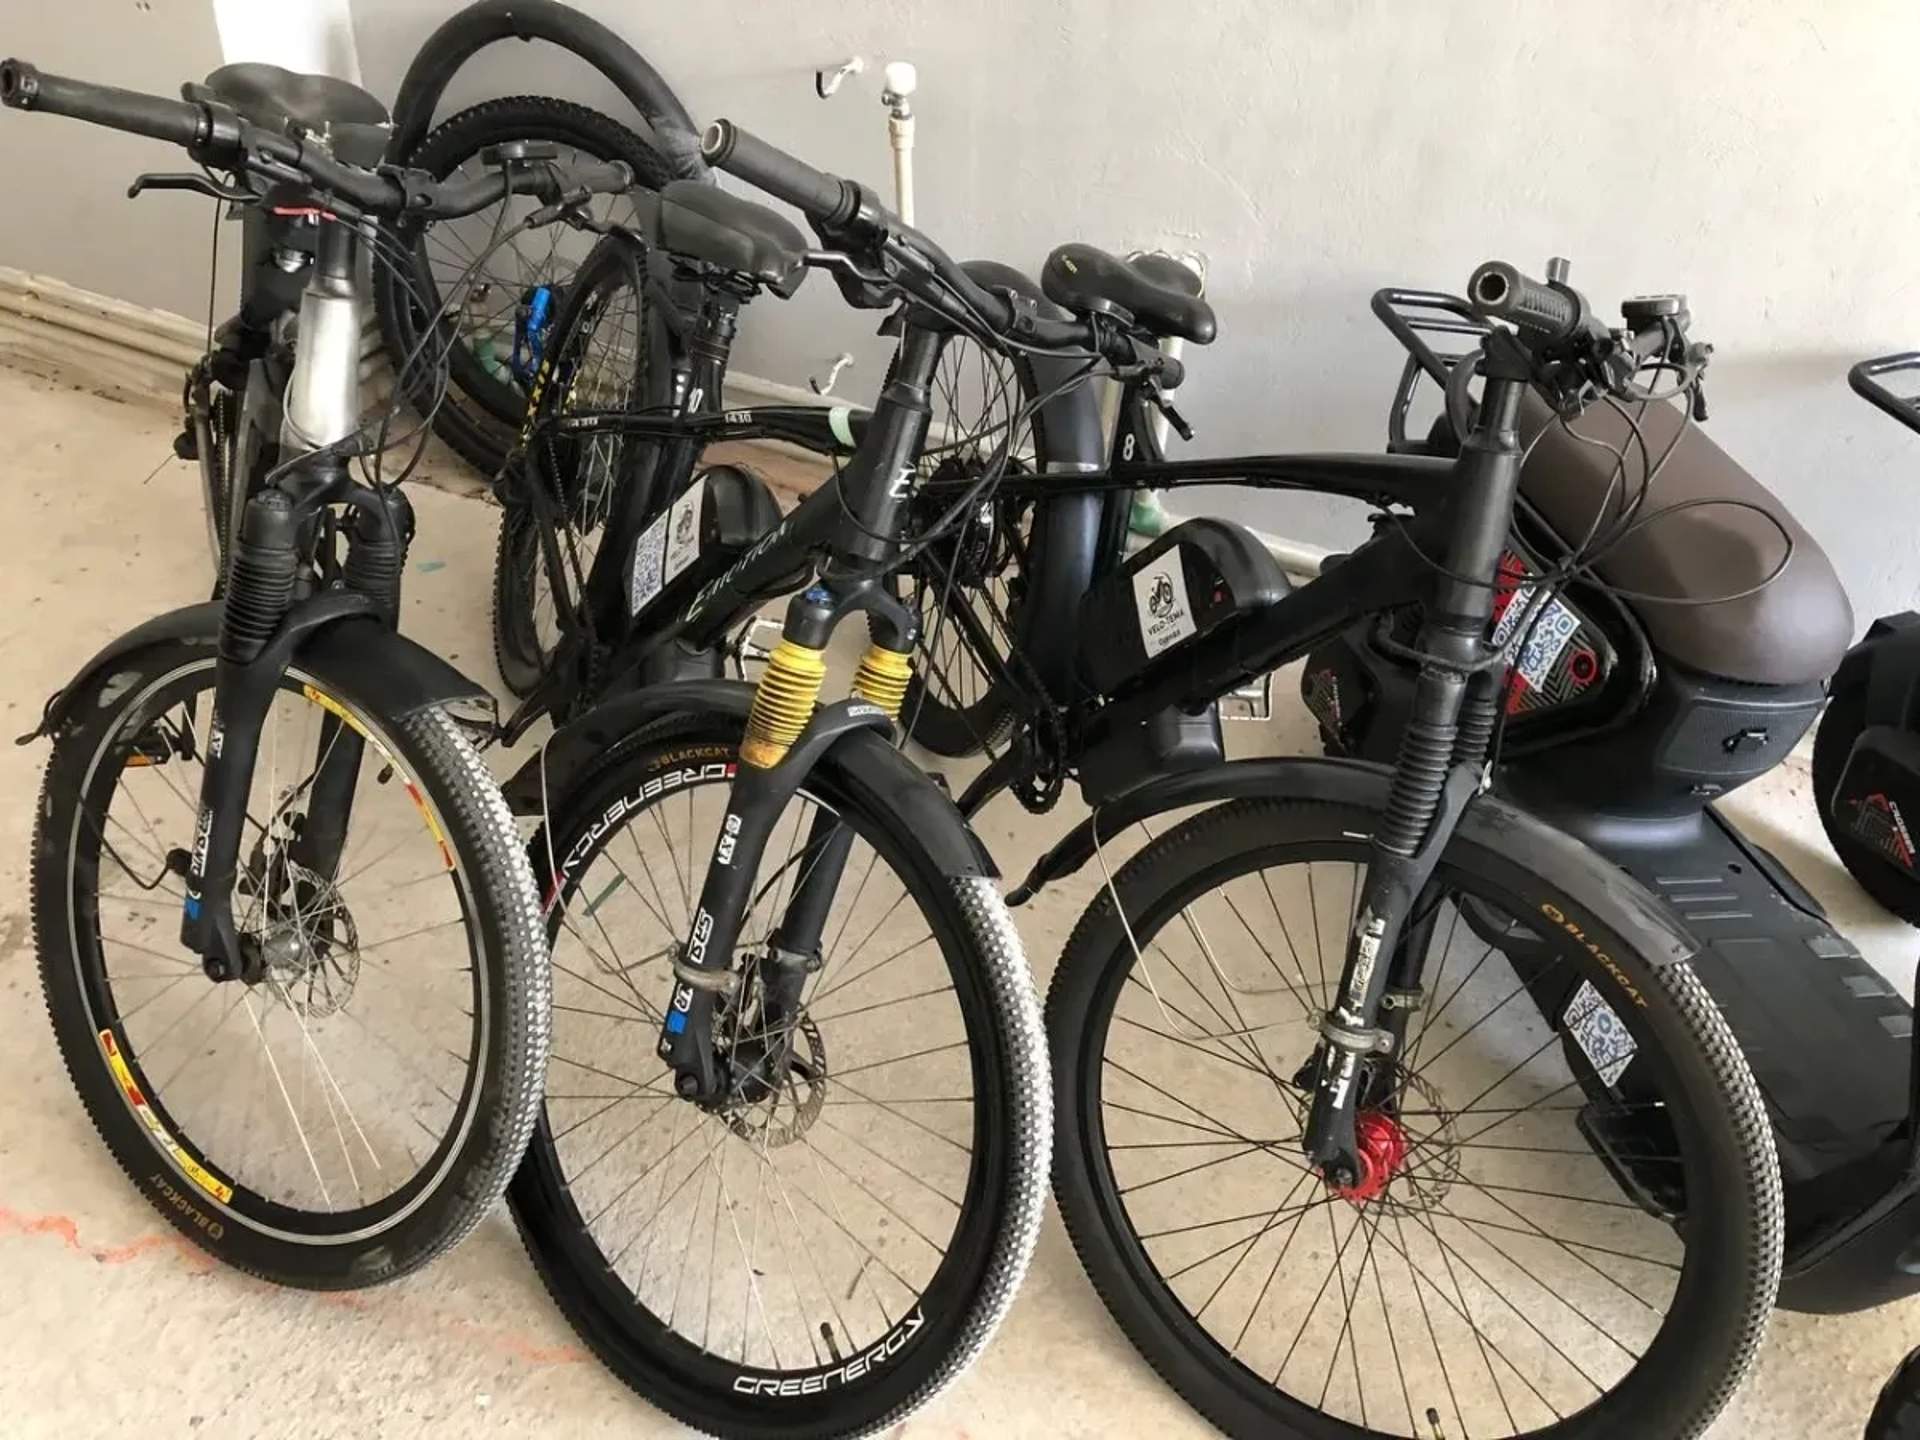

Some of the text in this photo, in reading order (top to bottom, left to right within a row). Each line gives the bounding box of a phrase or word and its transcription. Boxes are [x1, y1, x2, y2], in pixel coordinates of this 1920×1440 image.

[1123, 433, 1135, 461] 8
[660, 747, 729, 764] BLACKCAT
[562, 763, 727, 879] GREENERGY
[1566, 924, 1649, 1008] BLACKCAT
[151, 1172, 210, 1228] BLACKCAT
[733, 1305, 925, 1396] GREENERGY
